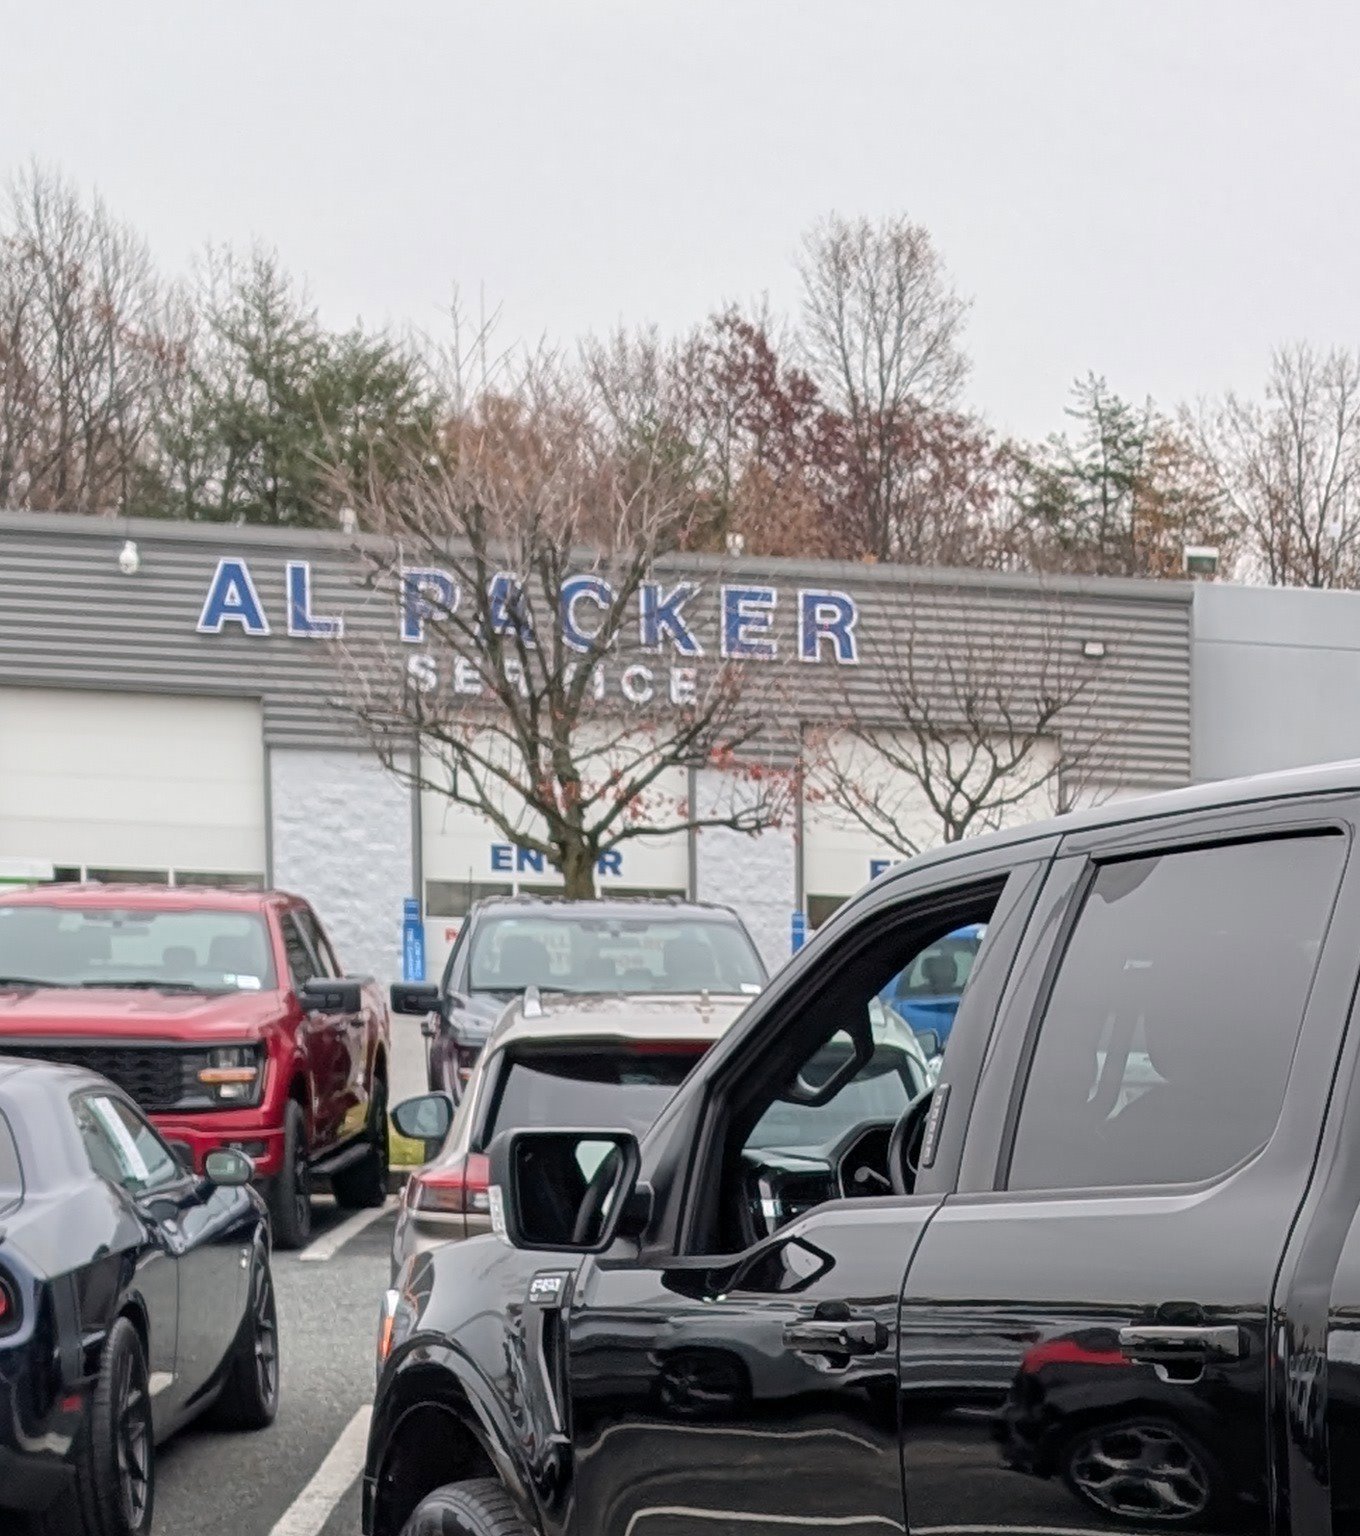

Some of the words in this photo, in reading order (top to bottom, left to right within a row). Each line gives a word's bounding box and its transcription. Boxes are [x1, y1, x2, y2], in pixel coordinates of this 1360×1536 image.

[195, 557, 344, 639] AL
[400, 566, 859, 666] PACKER
[491, 844, 623, 876] ENR
